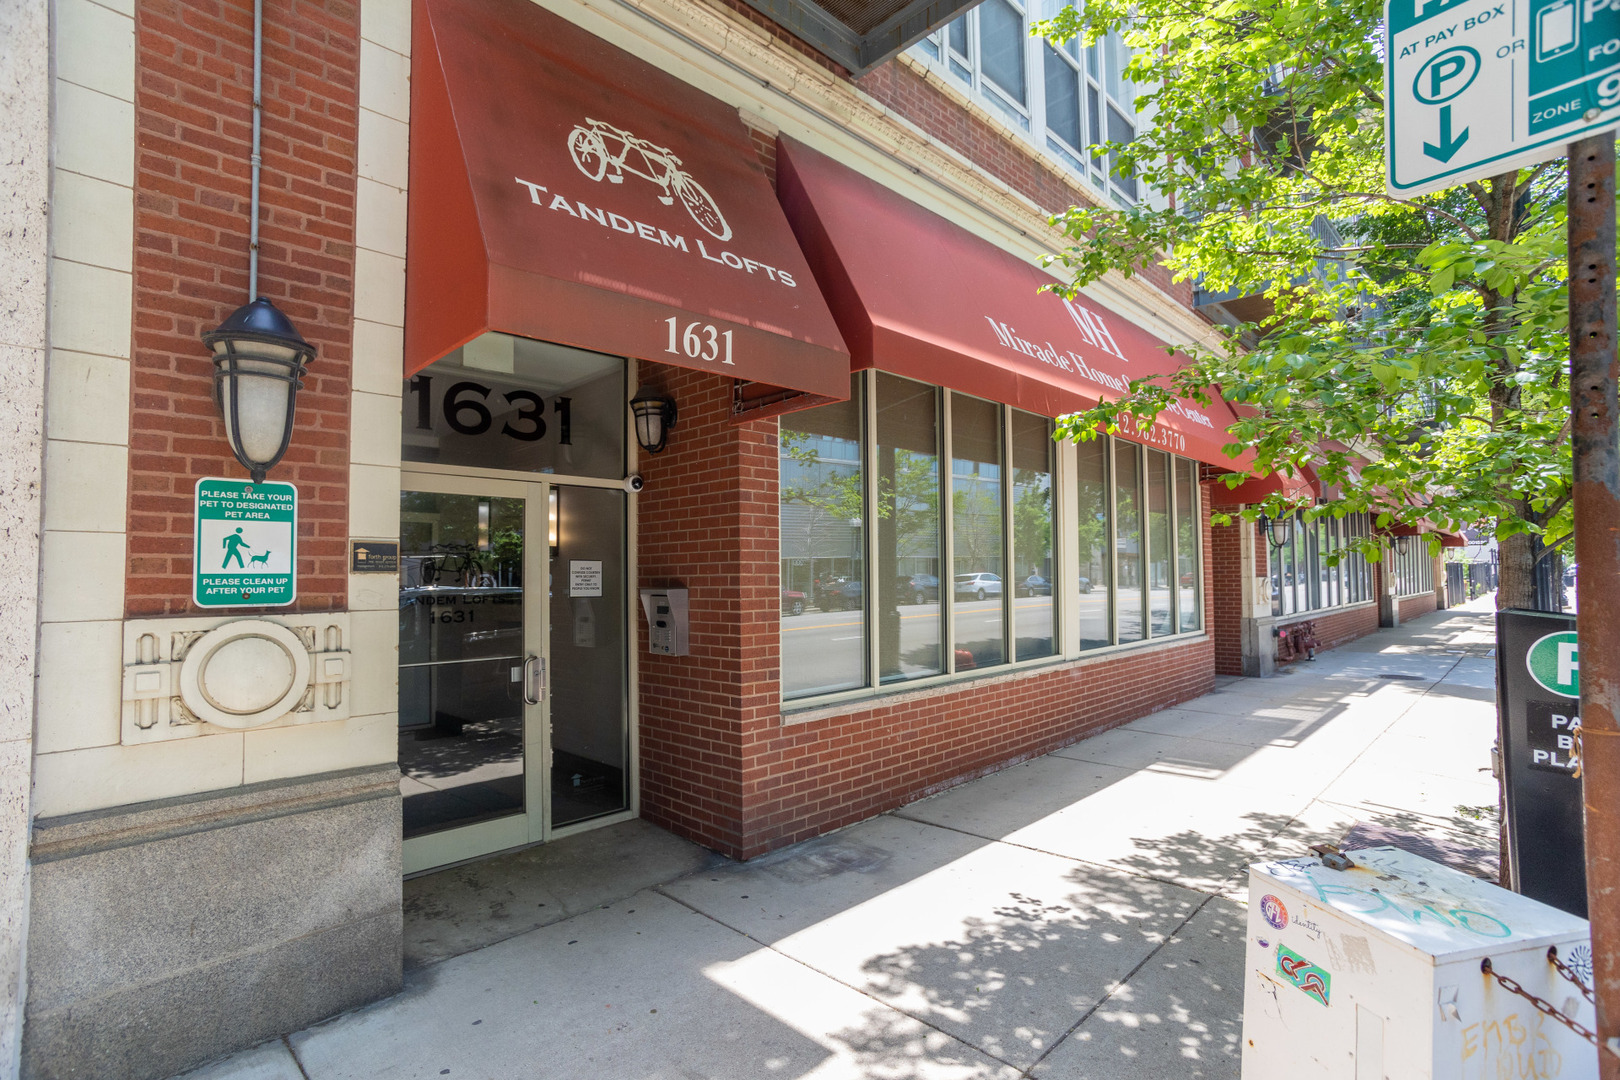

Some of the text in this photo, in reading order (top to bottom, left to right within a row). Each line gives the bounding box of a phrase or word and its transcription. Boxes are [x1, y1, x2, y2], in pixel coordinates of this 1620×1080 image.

[1399, 41, 1420, 59] AT
[1425, 24, 1458, 48] PAY
[1464, 5, 1506, 32] BOX
[1496, 39, 1526, 59] OR
[1431, 55, 1466, 98] P
[1532, 99, 1582, 124] ZONE
[515, 177, 798, 287] TANDEM LOFTS
[664, 317, 736, 366] 1631
[984, 315, 1215, 429] Miracle Home Center
[410, 375, 573, 445] 1631
[201, 490, 293, 502] PLEASE TAKE YOUR
[236, 501, 293, 511] DESIGNATED
[225, 511, 271, 520] PET AREA
[203, 578, 241, 586] PLEASE
[275, 577, 289, 585] UP
[205, 587, 238, 595] AFTER
[268, 586, 285, 594] PET
[463, 594, 506, 605] LOFTS
[431, 610, 474, 624] 1631
[1557, 734, 1582, 750] B
[1291, 915, 1321, 939] identity
